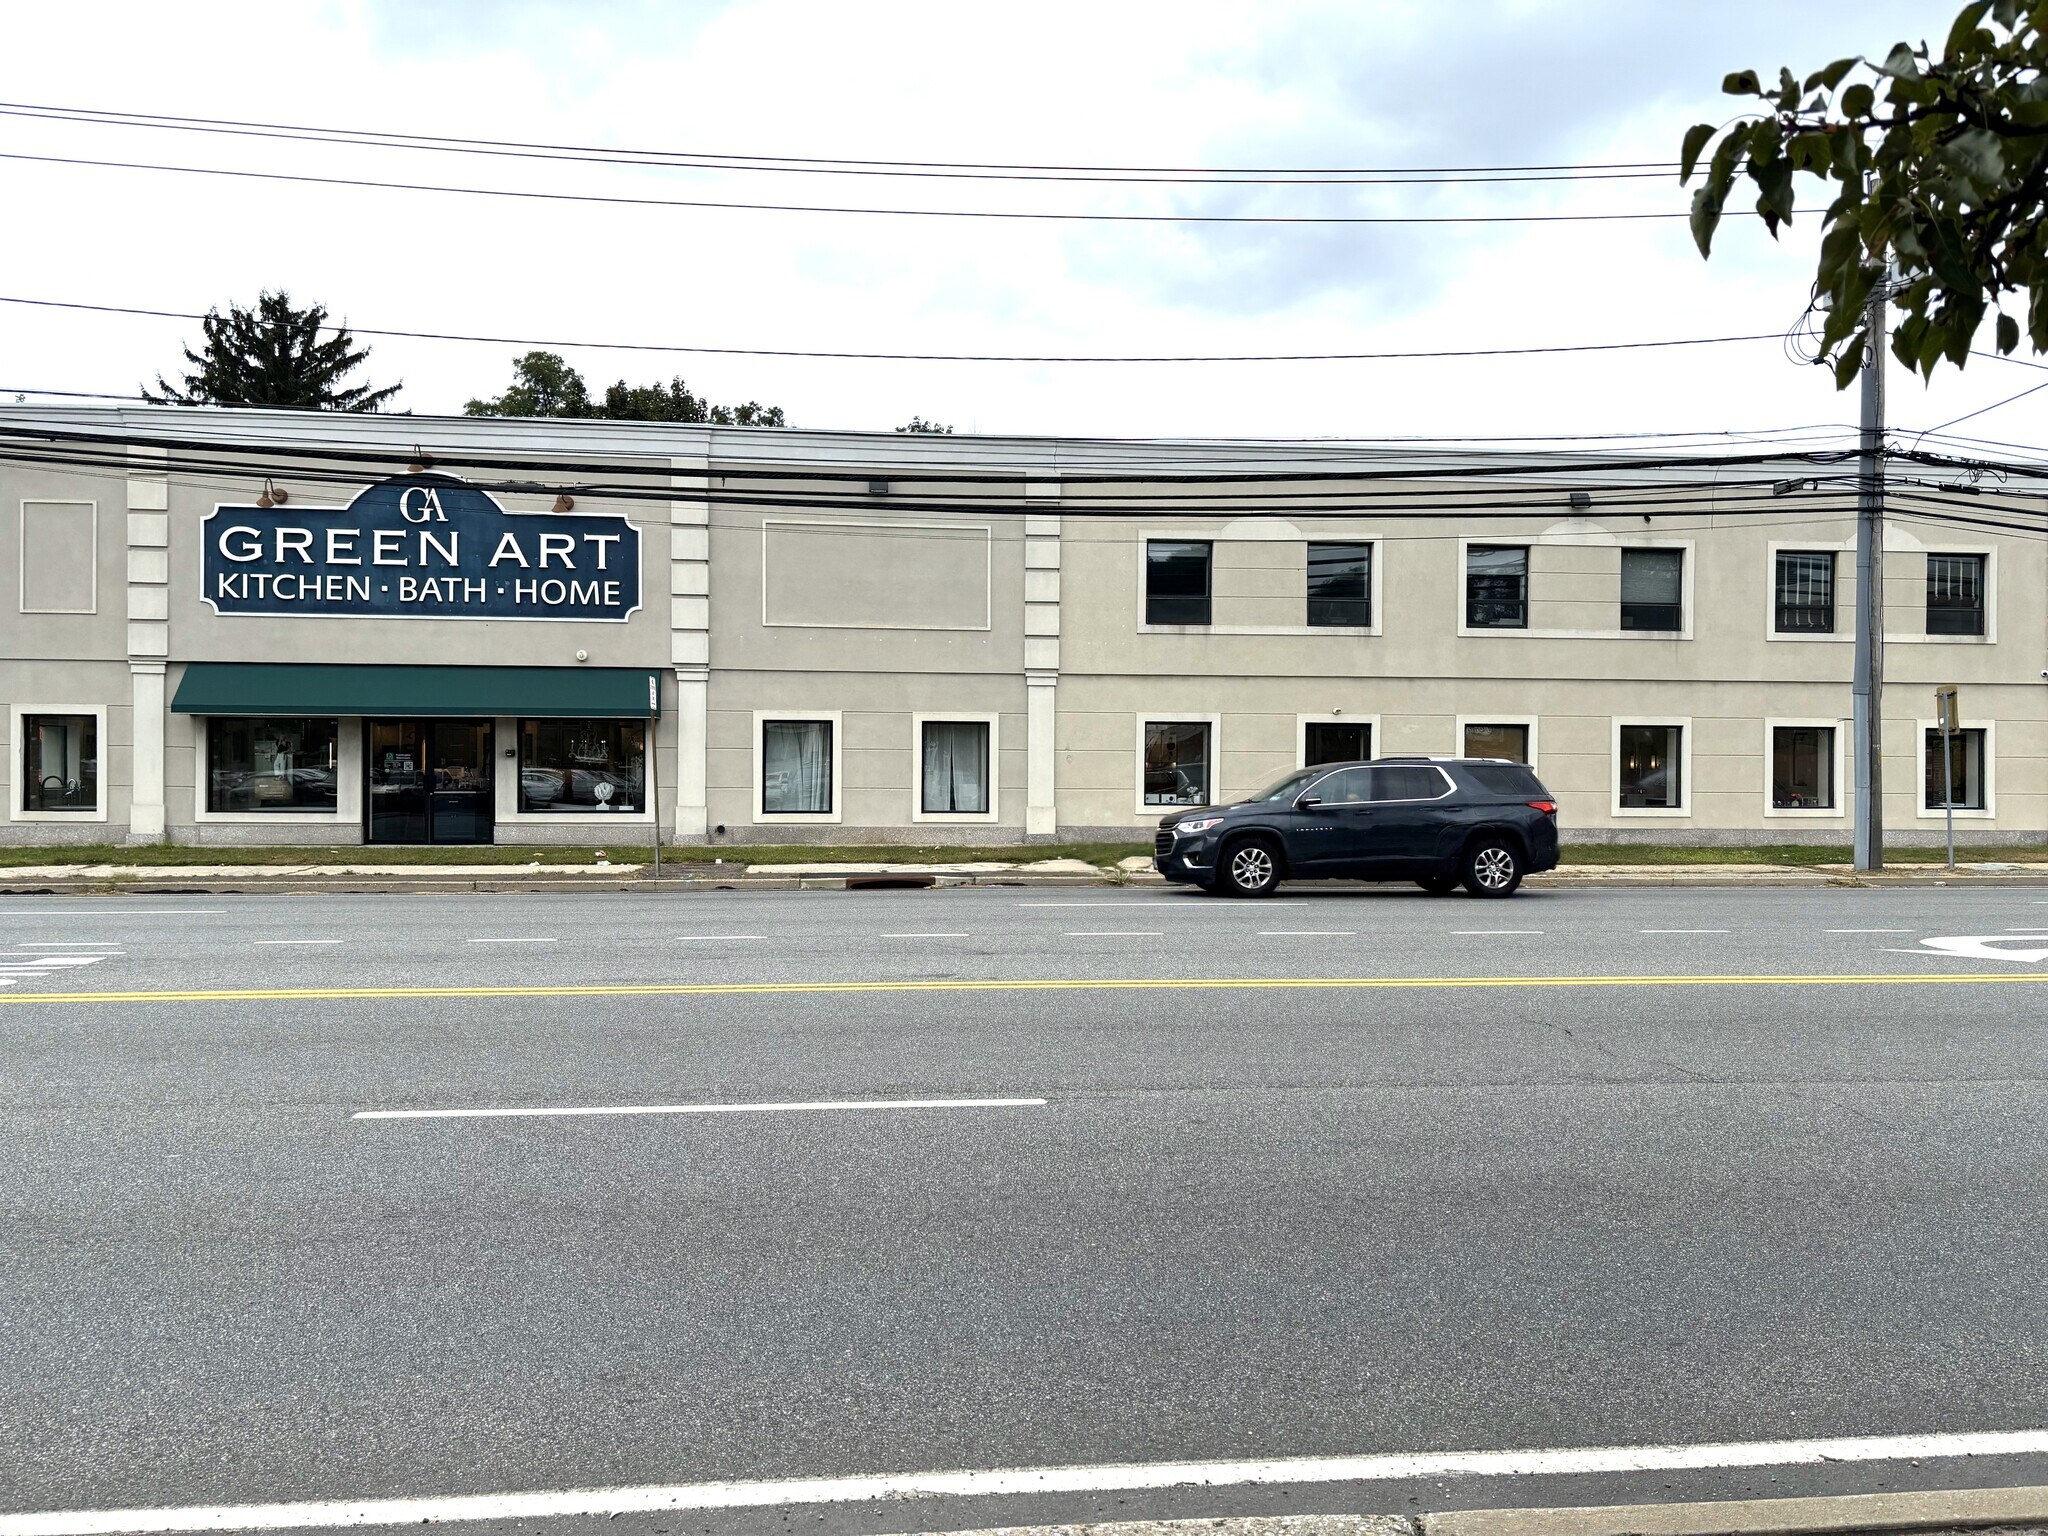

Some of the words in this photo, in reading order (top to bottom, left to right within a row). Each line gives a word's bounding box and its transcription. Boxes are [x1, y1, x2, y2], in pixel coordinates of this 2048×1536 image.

[400, 486, 449, 523] GA
[218, 525, 460, 567] GREEN
[488, 532, 621, 570] ART
[218, 573, 370, 601] KITCHEN
[399, 576, 487, 603] BATH
[515, 579, 621, 606] HOME
